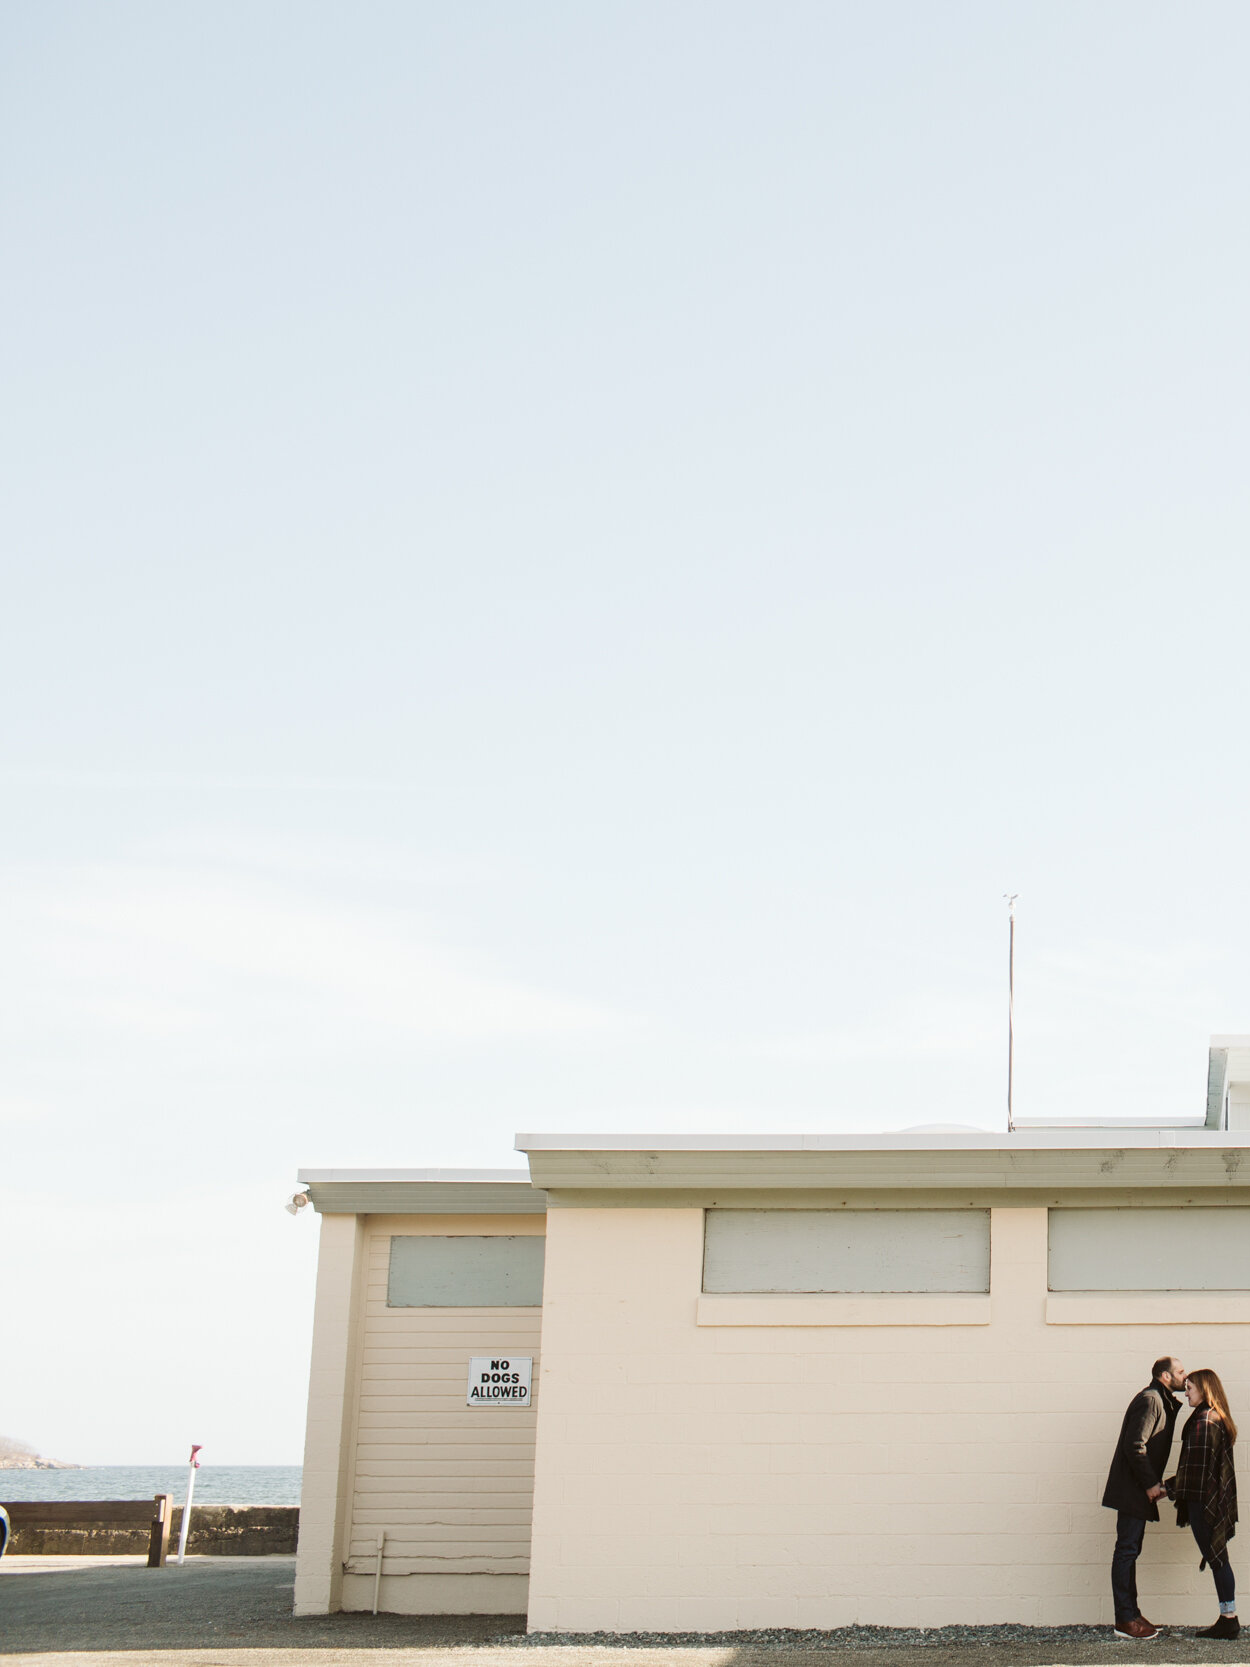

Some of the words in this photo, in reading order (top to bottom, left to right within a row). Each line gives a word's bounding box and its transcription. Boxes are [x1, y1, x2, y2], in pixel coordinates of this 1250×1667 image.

[491, 1361, 509, 1370] NO
[481, 1373, 519, 1383] DOGS
[471, 1386, 527, 1397] ALLOWED
